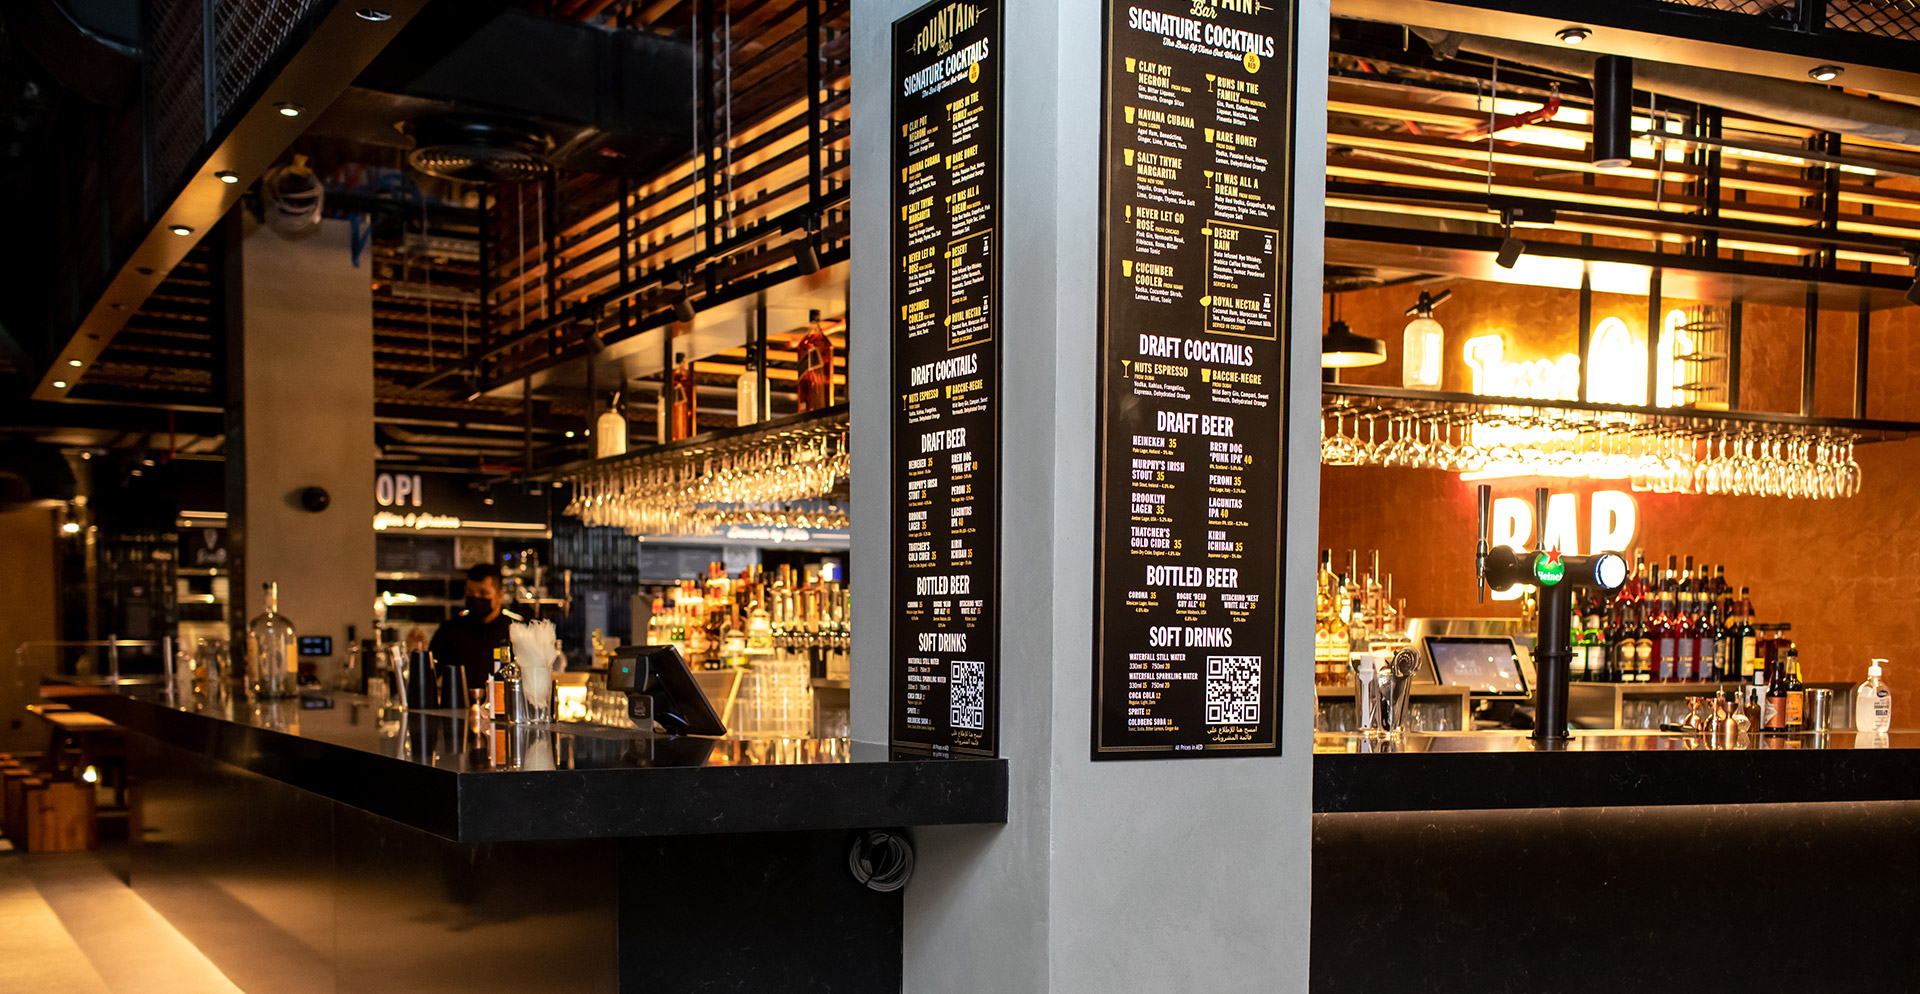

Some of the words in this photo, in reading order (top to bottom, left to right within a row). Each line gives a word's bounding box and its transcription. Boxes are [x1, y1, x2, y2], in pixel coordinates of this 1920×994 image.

[1190, 1, 1217, 19] Bar
[917, 2, 974, 54] FOUNTAIN
[1129, 6, 1201, 42] SIGNATURE
[1204, 22, 1274, 58] COCKTAILS
[904, 59, 944, 96] SIGNATURE
[945, 36, 988, 76] COCKTAILS
[1139, 60, 1156, 73] CLAY
[1158, 64, 1171, 76] POT
[1138, 72, 1169, 88] NEGRONI
[1217, 76, 1235, 90] RUNS
[1237, 80, 1244, 91] IN
[1246, 82, 1258, 94] THE
[1217, 88, 1240, 102] FAMILY
[1138, 108, 1165, 123] HAVANA
[1167, 113, 1194, 128] CUBANA
[1216, 130, 1233, 143] RARE
[1235, 133, 1257, 147] HONEY
[1137, 151, 1158, 164] SALTY
[1159, 155, 1182, 169] THYME
[1137, 163, 1176, 180] MARGARITA
[1215, 171, 1222, 182] IT
[1224, 173, 1238, 185] WAS
[1239, 176, 1252, 188] ALL
[1253, 178, 1258, 188] A
[1215, 183, 1238, 197] DREAM
[1136, 206, 1158, 219] NEVER
[1160, 210, 1173, 222] LET
[1174, 212, 1184, 224] GO
[1136, 218, 1154, 231] ROSE
[1214, 227, 1239, 240] DESERT
[1214, 239, 1230, 251] RAIN
[1135, 261, 1173, 277] CUCUMBER
[1135, 274, 1162, 287] COOLER
[1213, 295, 1233, 308] ROYAL
[1235, 298, 1260, 311] NECTAR
[1140, 333, 1181, 358] DRAFT
[1184, 338, 1253, 366] COCKTAILS
[911, 363, 934, 386] DRAFT
[935, 353, 977, 381] COCKTAILS
[1134, 361, 1152, 373] NUTS
[1154, 363, 1188, 377] ESPRESSO
[1212, 370, 1261, 384] BACCHE-NEGRE
[1157, 410, 1198, 434] DRAFT
[1202, 414, 1233, 437] BEER
[921, 430, 945, 453] DRAFT
[946, 427, 965, 449] BEER
[1133, 435, 1165, 447] HEINEKEN
[1168, 438, 1176, 448] 35
[1210, 441, 1228, 452] BREW
[1229, 443, 1242, 453] DOG
[1132, 458, 1165, 470] MURPHY'S
[1167, 461, 1184, 471] IRISH
[1132, 469, 1153, 480] STOUT
[1156, 471, 1164, 481] 35
[1209, 474, 1232, 485] PERONI
[1233, 476, 1241, 486] 35
[1132, 492, 1165, 504] BROOKLYN
[1208, 497, 1242, 508] LAGUNITAS
[1131, 503, 1152, 514] LAGER
[1156, 505, 1164, 514] 35
[1208, 508, 1219, 517] IPA
[1220, 508, 1228, 518] 40
[1131, 526, 1170, 538] THATCHER'S
[1208, 530, 1226, 540] KIRIN
[1131, 537, 1148, 547] GOLD
[1150, 538, 1170, 548] CIDER
[1174, 539, 1182, 549] 35
[1208, 541, 1233, 551] ICHIBAN
[1235, 542, 1243, 551] 35
[1146, 565, 1202, 586] BOTTLED
[1206, 567, 1238, 588] BEER
[917, 576, 948, 595] BOTTLED
[950, 575, 969, 594] BEER
[918, 633, 937, 651] SOFT
[938, 633, 966, 652] DRINKS
[1149, 626, 1182, 646] SOFT
[1185, 627, 1232, 647] DRINKS
